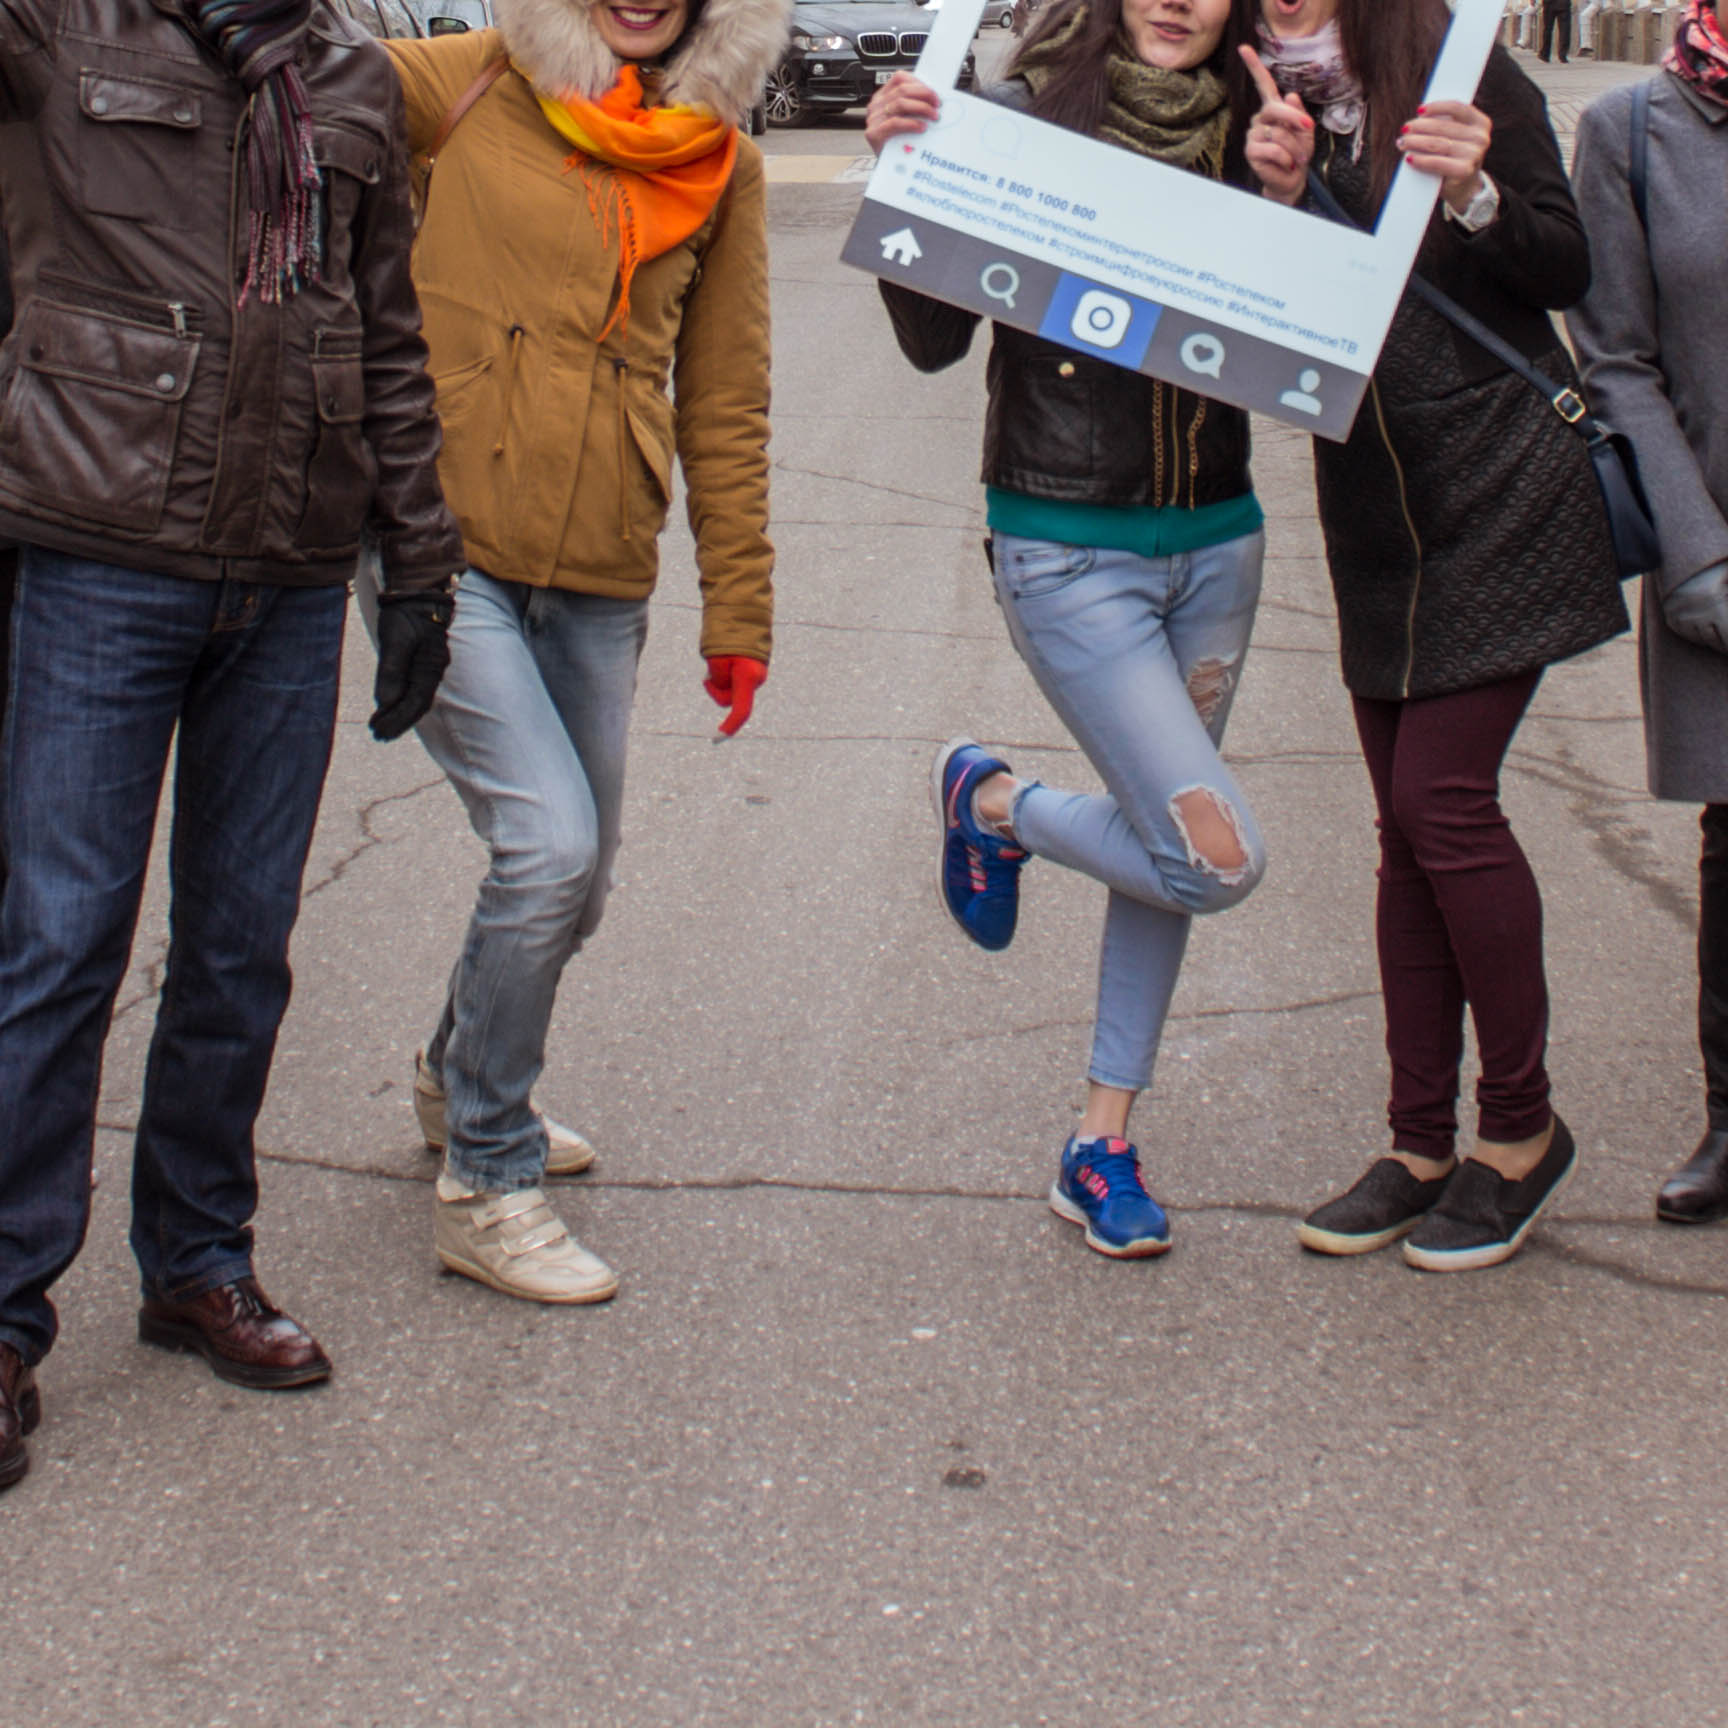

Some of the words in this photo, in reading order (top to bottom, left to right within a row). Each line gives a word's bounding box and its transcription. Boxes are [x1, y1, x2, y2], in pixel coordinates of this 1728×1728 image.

[920, 150, 991, 183] Нравится:
[995, 177, 1006, 189] 8
[1008, 181, 1034, 198] 800
[1038, 192, 1069, 211] 1000
[1071, 203, 1097, 221] 800
